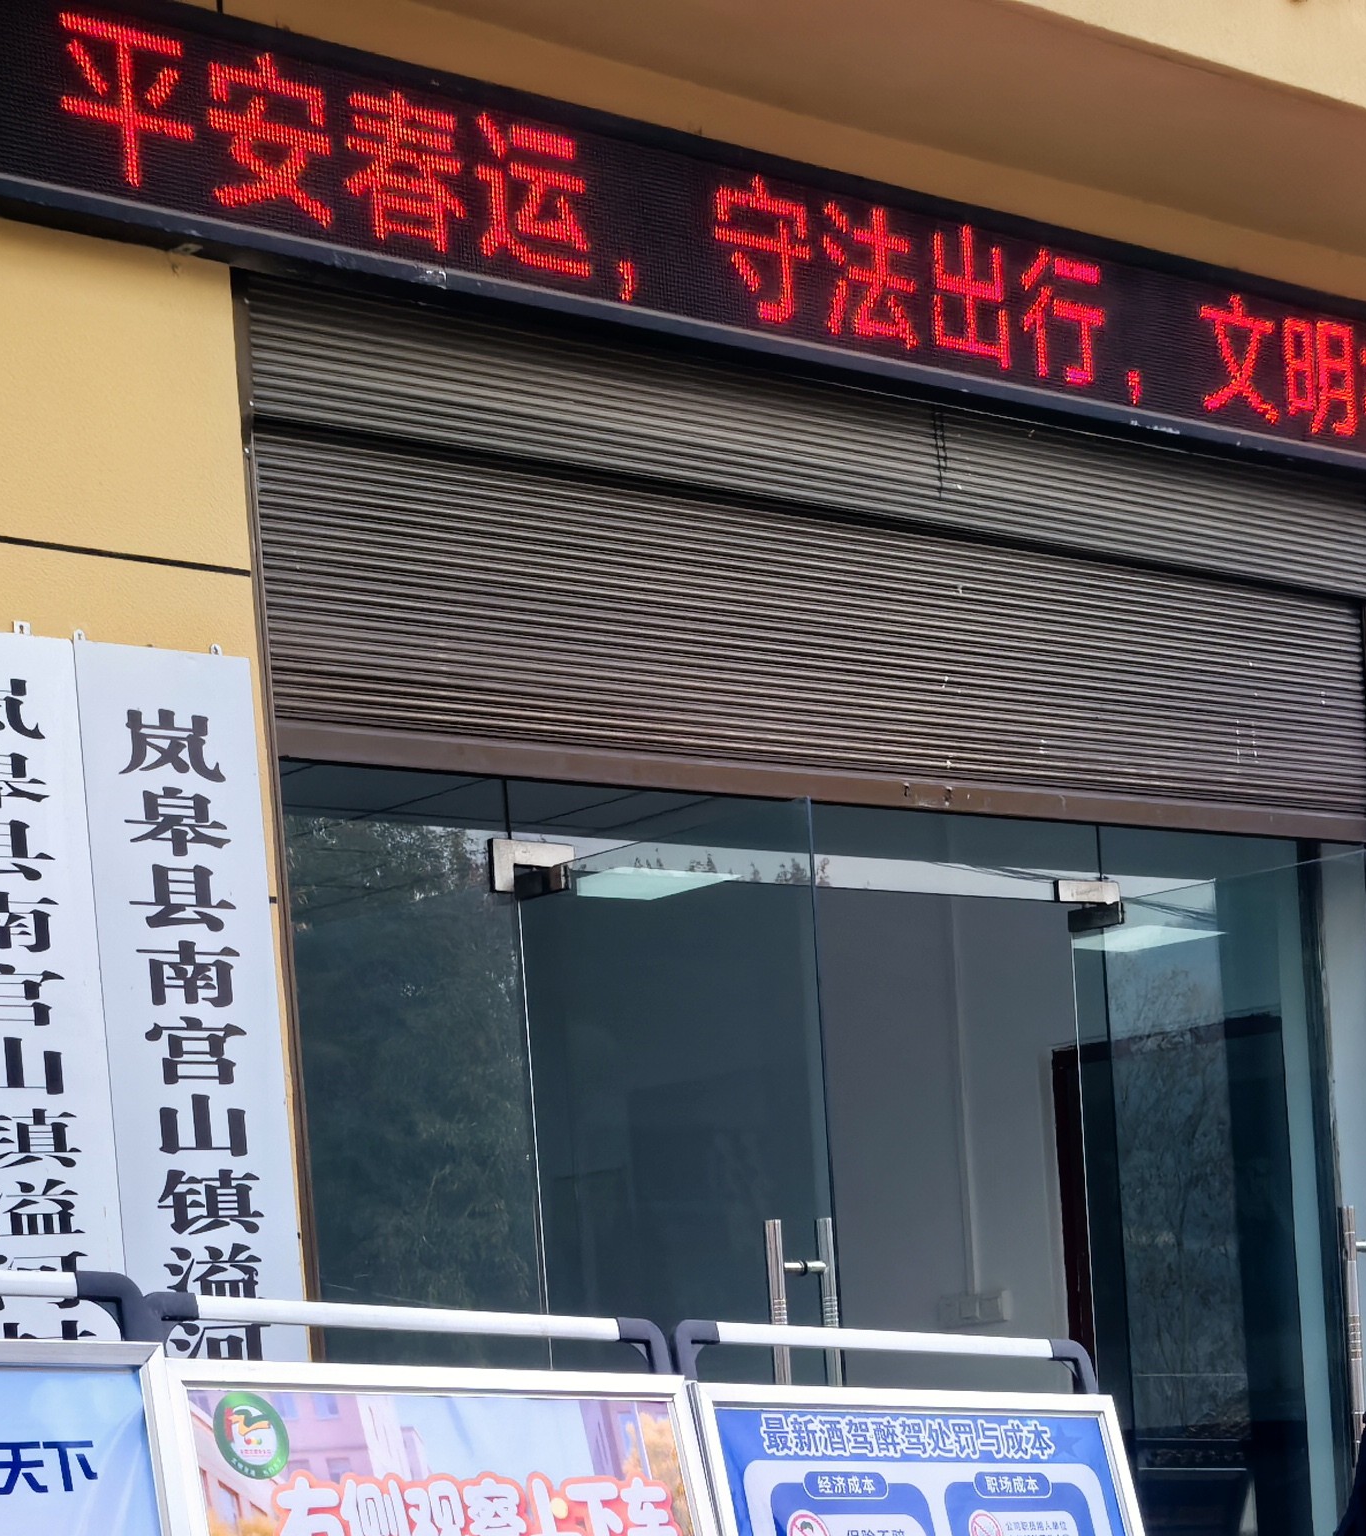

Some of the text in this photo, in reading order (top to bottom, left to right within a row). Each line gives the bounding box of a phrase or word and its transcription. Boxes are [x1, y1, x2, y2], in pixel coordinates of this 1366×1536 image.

[761, 1414, 1055, 1459] 最新酒驾醉驾处罚与成本
[818, 1476, 876, 1494] 经济成本
[985, 1476, 1040, 1494] 职场成本
